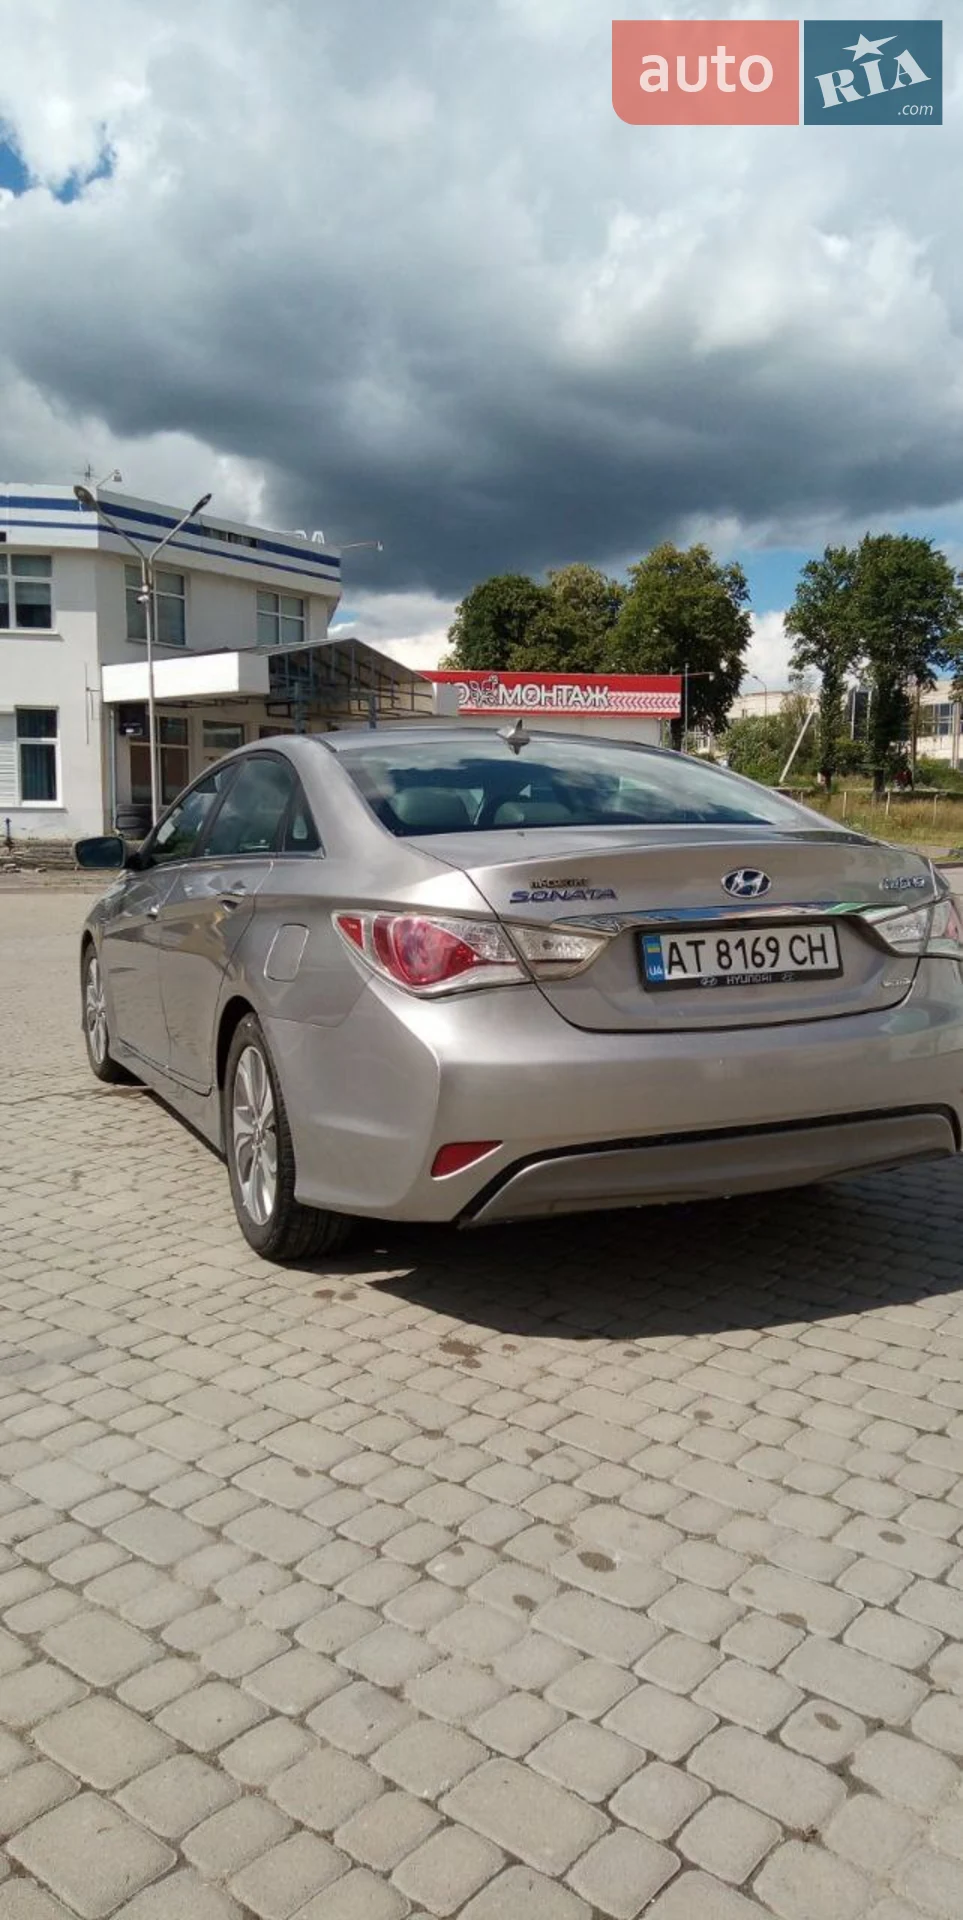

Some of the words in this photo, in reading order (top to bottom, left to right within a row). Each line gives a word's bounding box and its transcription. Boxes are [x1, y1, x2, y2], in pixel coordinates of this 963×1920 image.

[509, 887, 618, 904] SONATA
[667, 939, 706, 975] AT
[716, 935, 780, 970] 8169
[788, 932, 828, 965] CH
[726, 974, 772, 985] HYUNDAI
